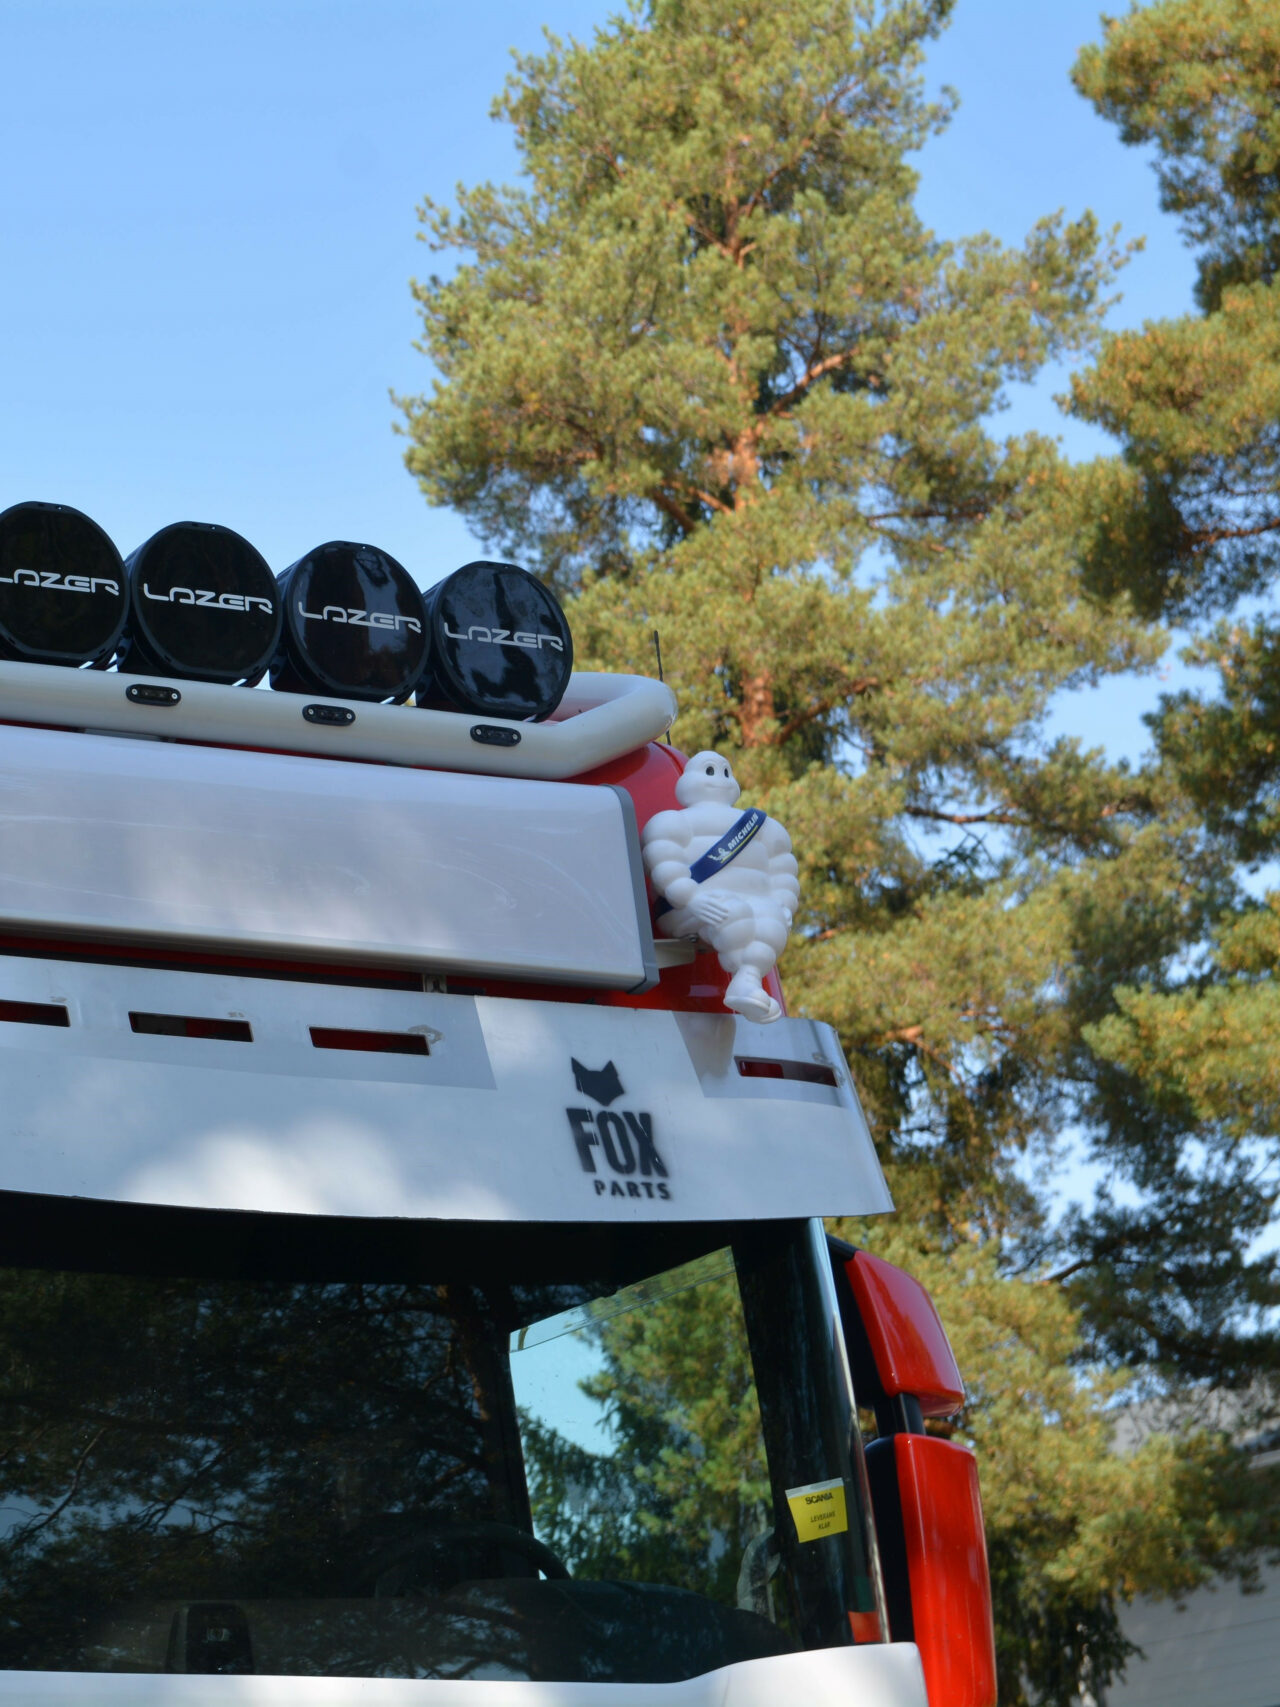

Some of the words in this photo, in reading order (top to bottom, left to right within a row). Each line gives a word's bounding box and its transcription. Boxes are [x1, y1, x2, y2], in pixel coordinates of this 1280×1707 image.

[143, 583, 273, 614] LAZER
[298, 601, 422, 633] LAZER
[443, 622, 564, 651] LAZER
[727, 812, 759, 849] MICHELIN
[566, 1107, 669, 1178] FOX
[593, 1179, 672, 1201] PARTS
[805, 1492, 833, 1505] SCANIA
